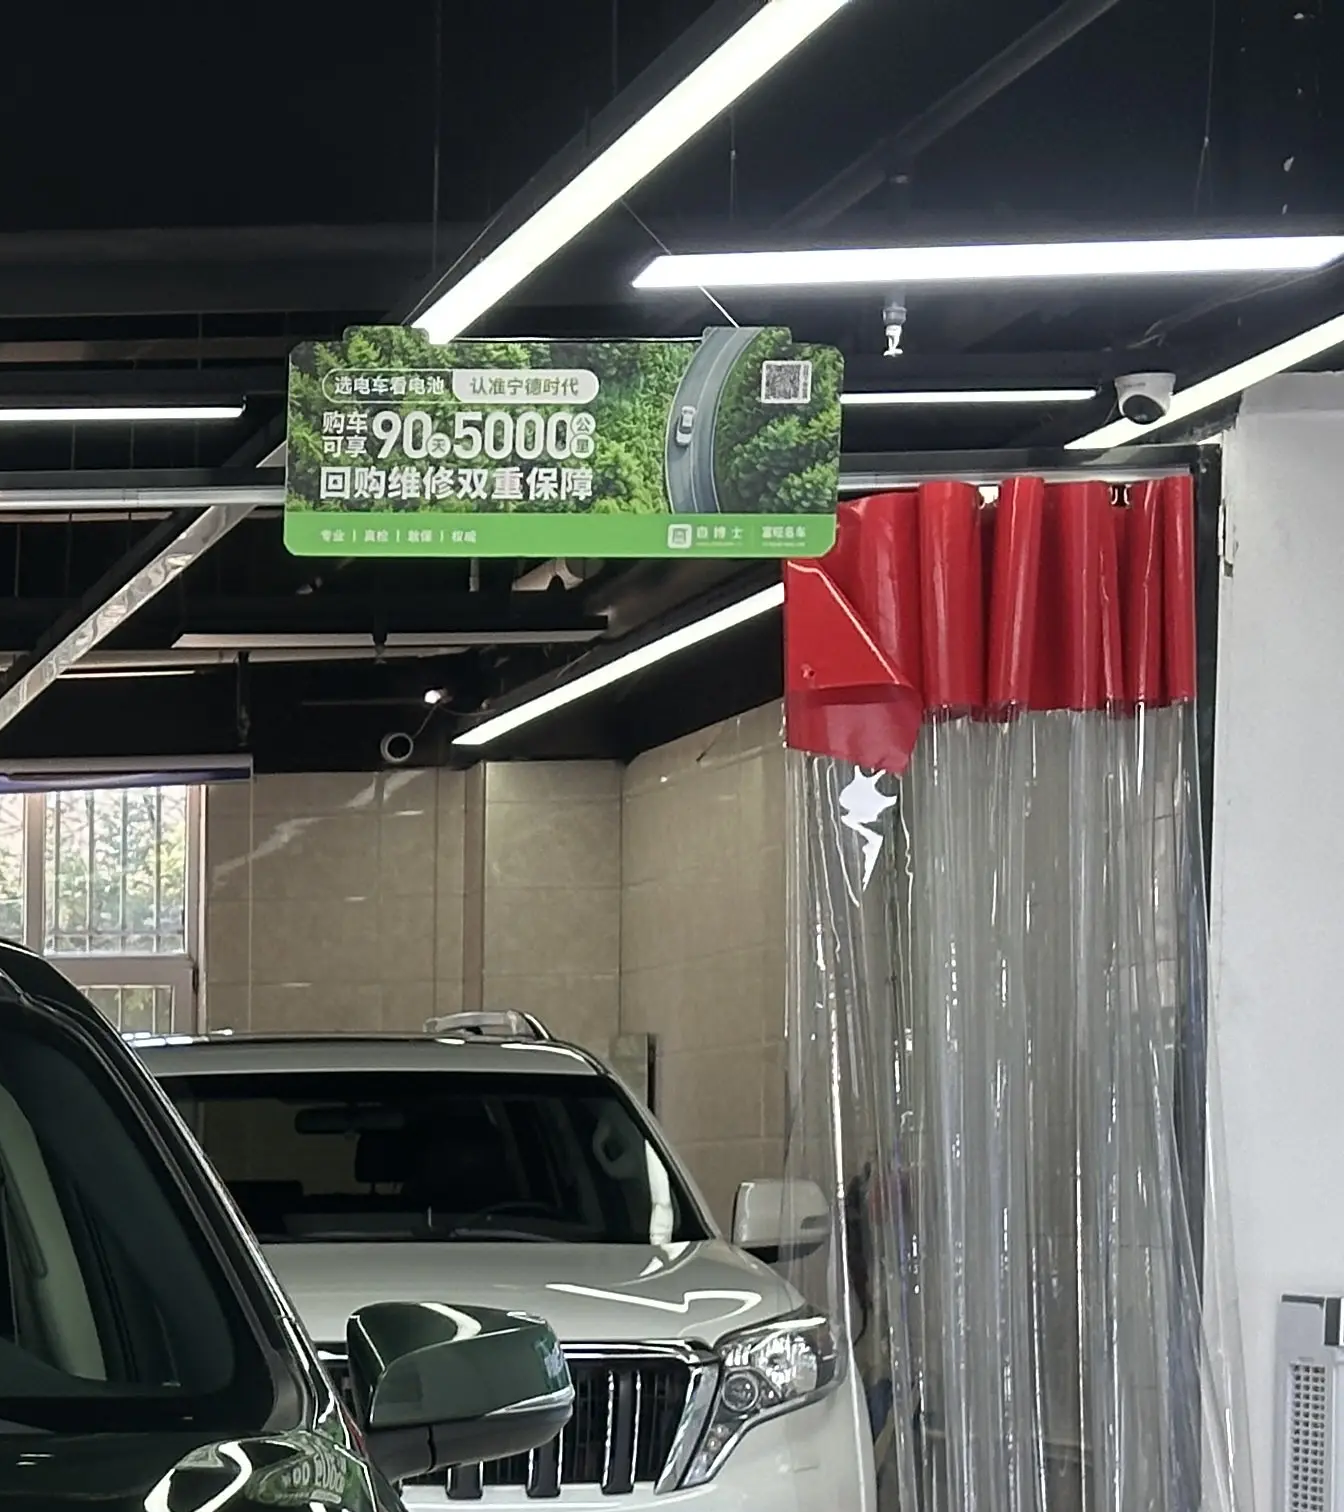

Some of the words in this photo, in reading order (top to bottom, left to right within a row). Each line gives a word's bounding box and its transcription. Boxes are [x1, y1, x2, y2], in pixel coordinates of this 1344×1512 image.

[334, 376, 445, 395] 选电车看电池
[470, 376, 579, 396] 认准宁德时代
[322, 410, 368, 434] 购车
[322, 435, 367, 458] 可享
[320, 466, 593, 500] 回购维修双重保障
